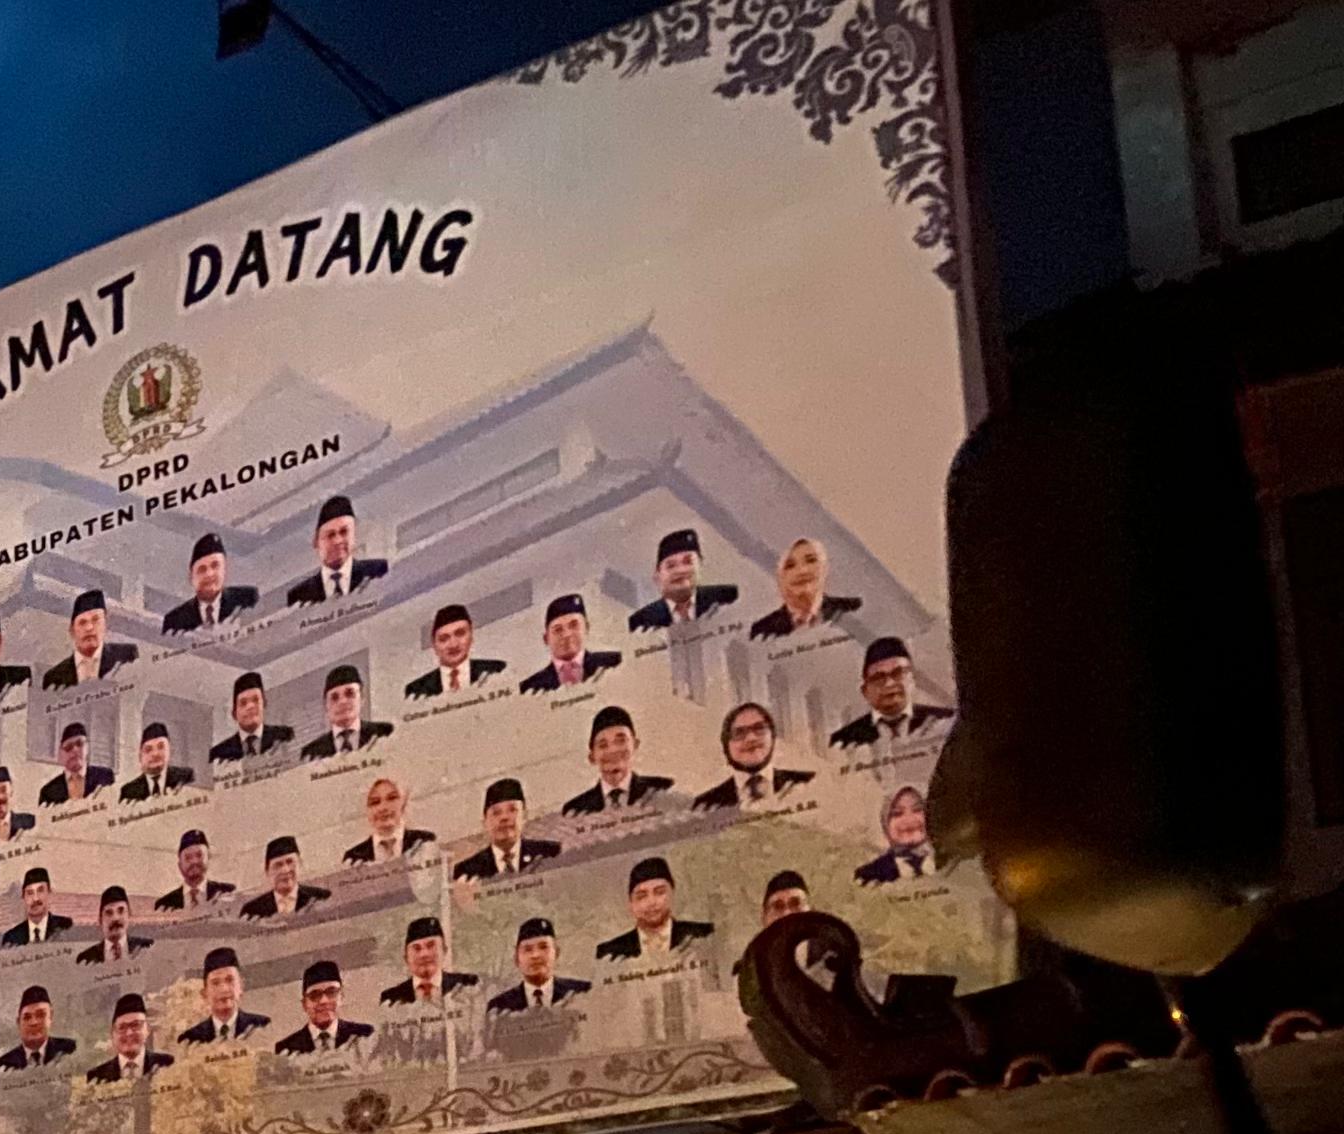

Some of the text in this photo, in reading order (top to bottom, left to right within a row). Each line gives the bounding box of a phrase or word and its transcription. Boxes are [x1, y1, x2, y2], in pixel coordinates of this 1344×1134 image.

[183, 208, 474, 307] DATANG
[118, 454, 190, 492] DPRD
[145, 435, 342, 516] PEKALONGAN
